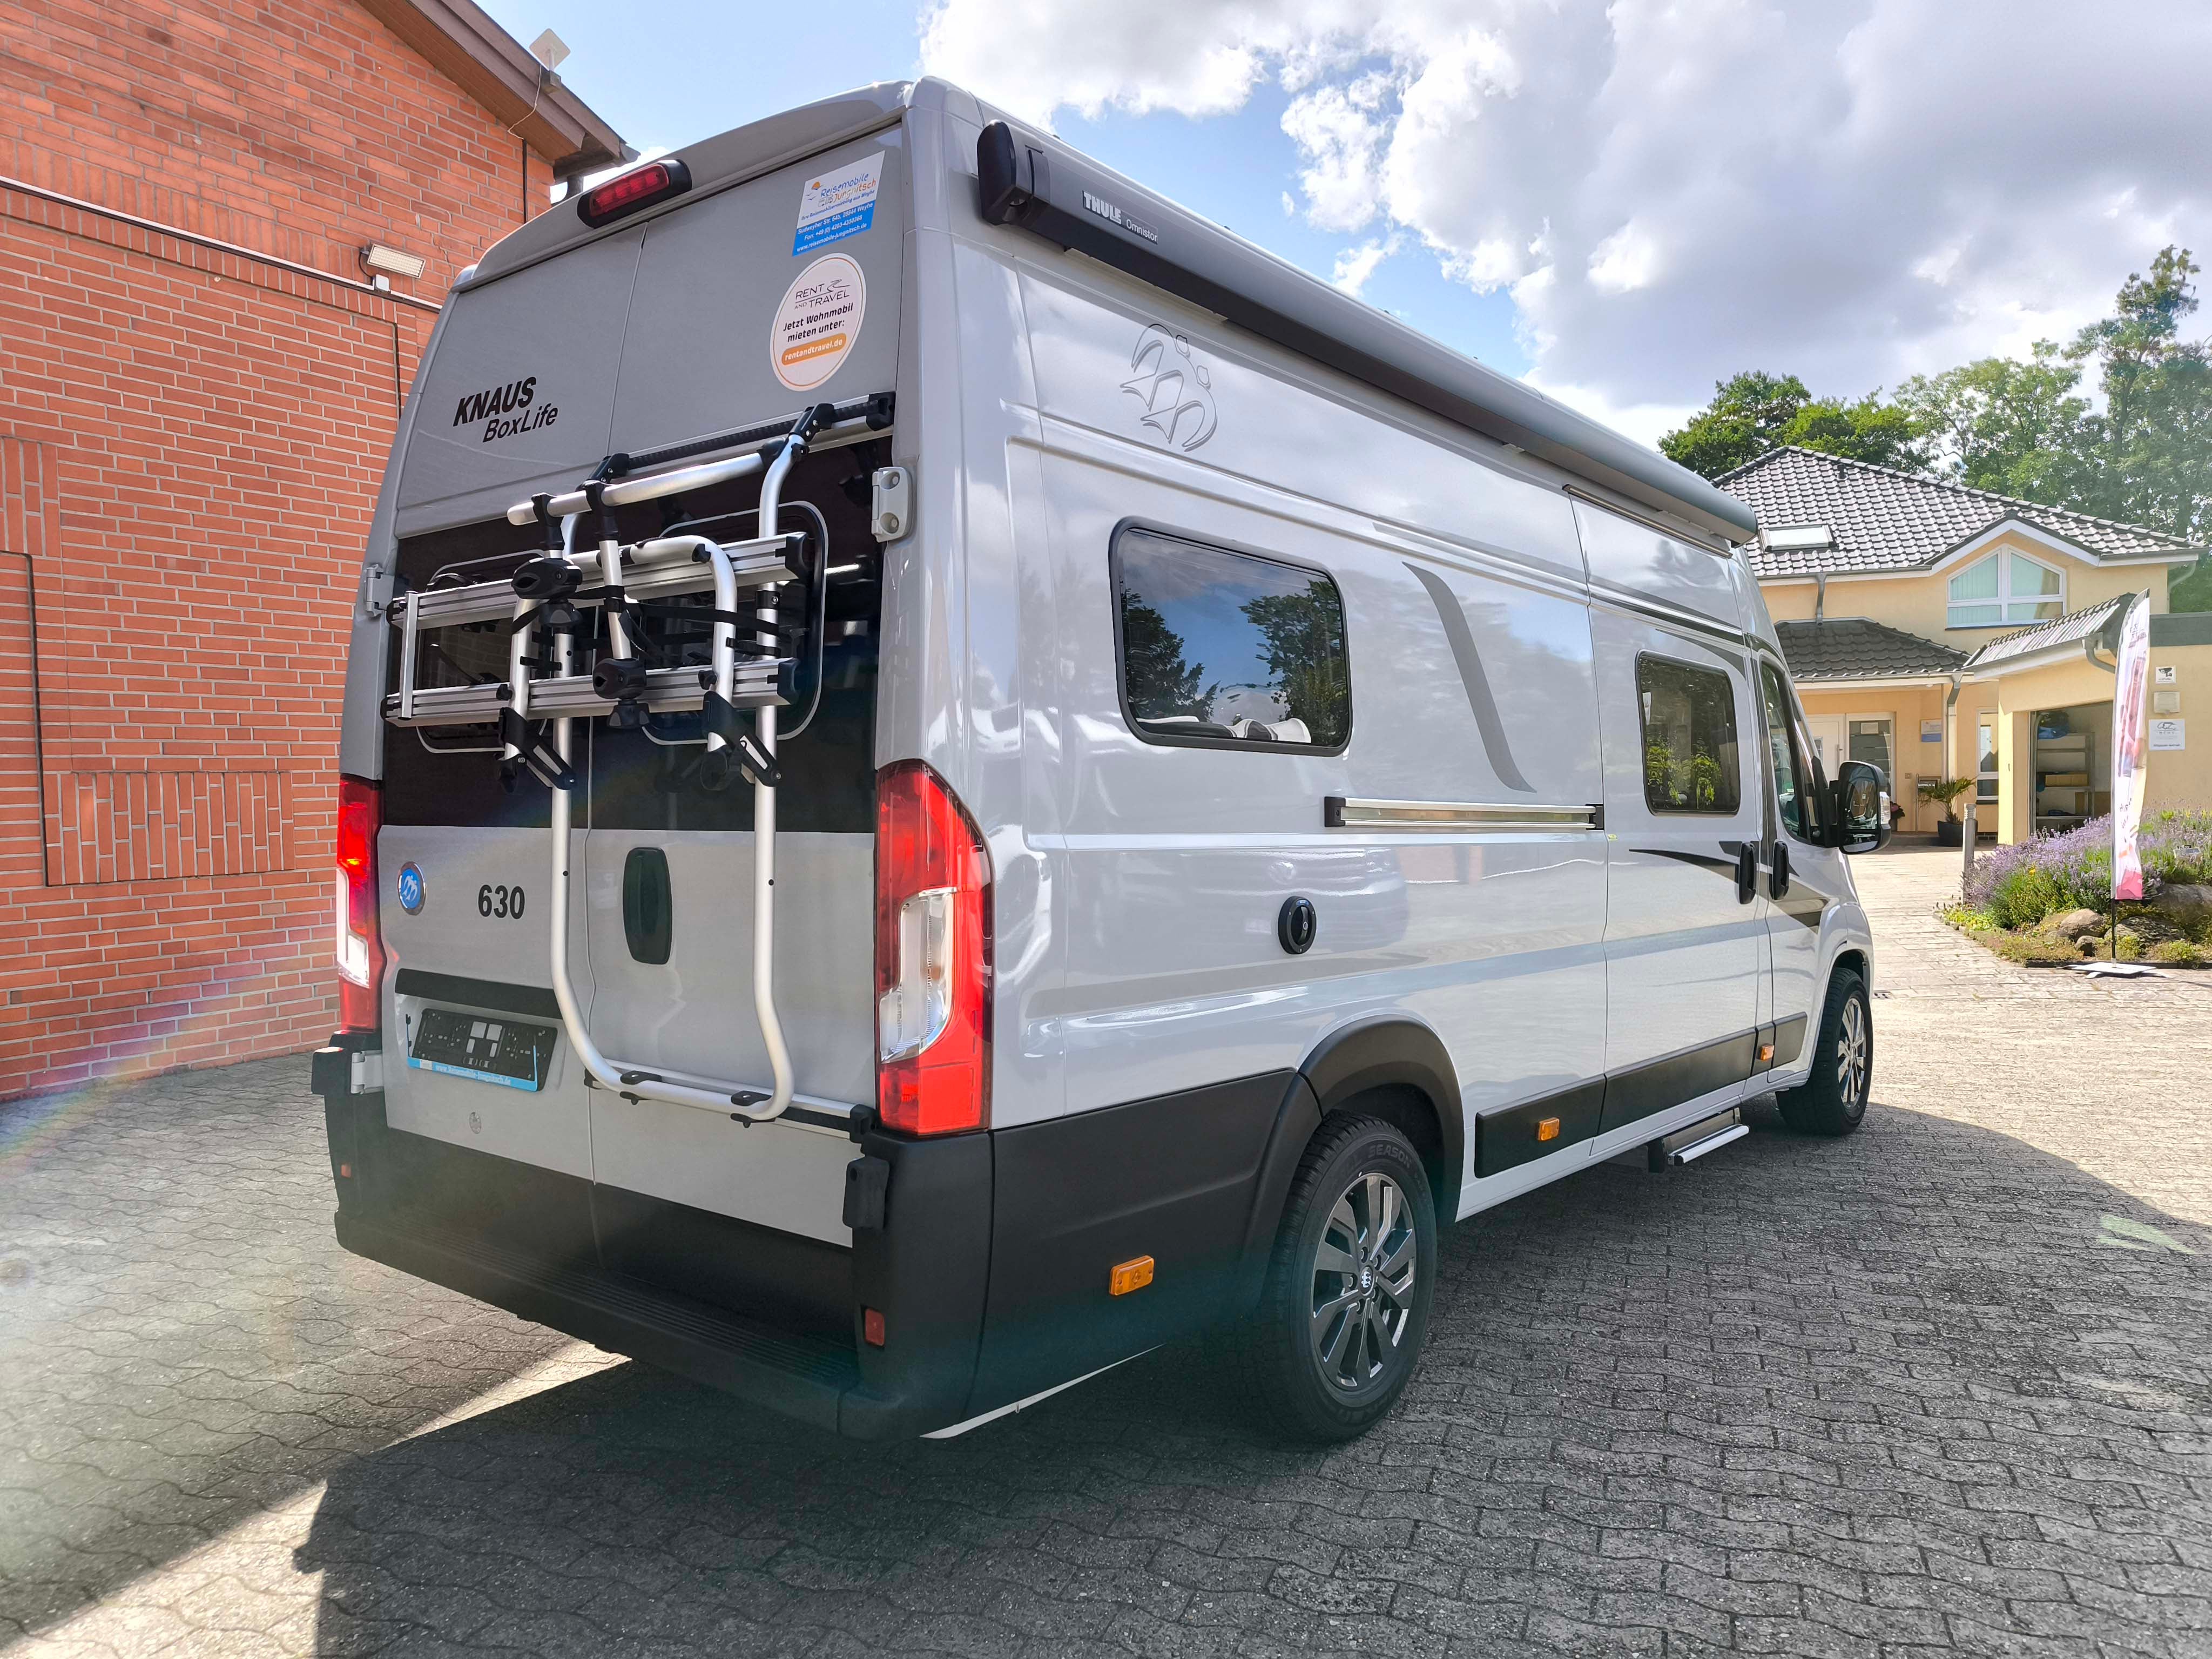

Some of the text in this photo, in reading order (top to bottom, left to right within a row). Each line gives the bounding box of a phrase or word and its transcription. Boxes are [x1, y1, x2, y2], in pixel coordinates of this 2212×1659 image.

[820, 173, 869, 197] Reisemobile
[834, 178, 876, 203] Jungnitsch
[857, 203, 873, 212] Weyhe
[1084, 192, 1158, 242] THULE Omnistor
[795, 284, 825, 300] RENT
[808, 289, 849, 308] TRAVEL
[783, 302, 853, 332] Jetzt Wohnmobil
[787, 320, 845, 342] mieten unter:
[785, 338, 842, 361] rentandtravel.de
[453, 377, 536, 427] KNAUS
[483, 403, 558, 442] BoxLife
[478, 885, 525, 919] 630
[1368, 1144, 1411, 1168] SEASON
